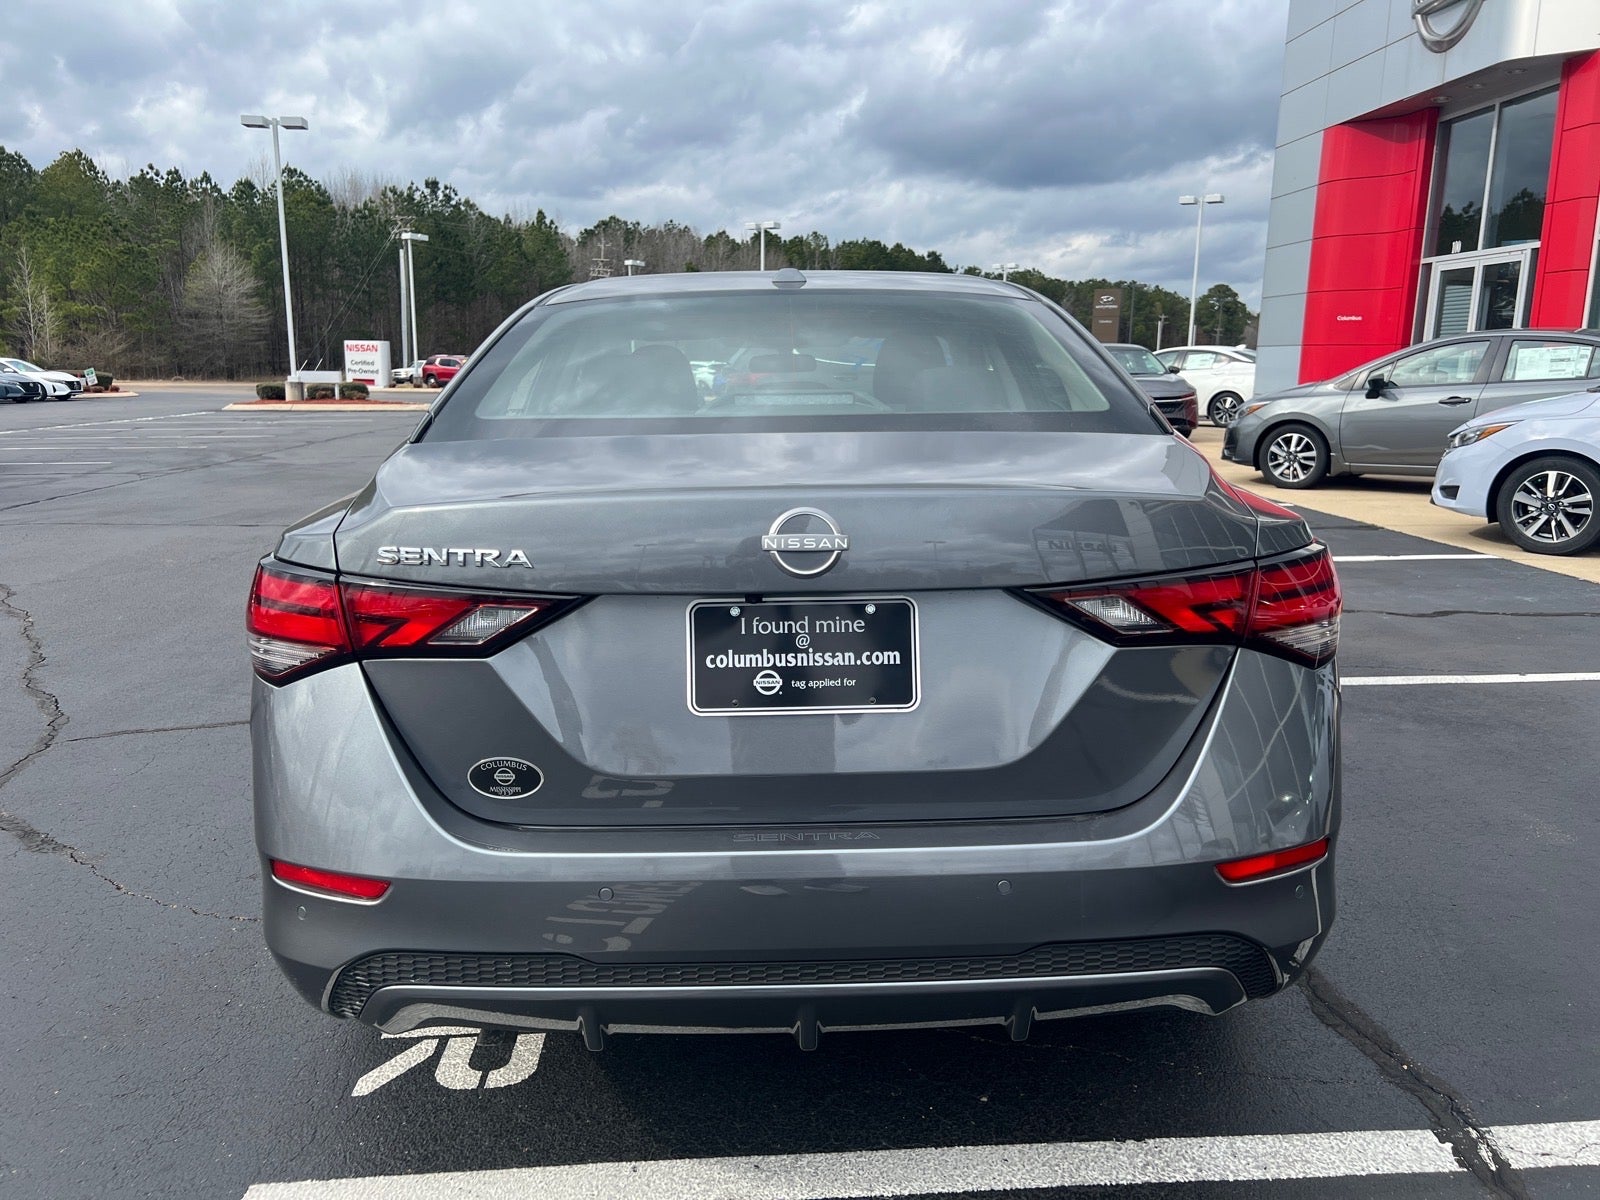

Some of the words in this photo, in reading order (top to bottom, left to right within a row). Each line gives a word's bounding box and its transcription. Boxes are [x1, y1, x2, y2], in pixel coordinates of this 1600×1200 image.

[345, 343, 379, 353] NISSAN
[350, 359, 375, 367] Certified
[347, 367, 379, 375] Pre-Owned
[764, 537, 848, 549] NISSAN
[376, 546, 534, 568] SENTRA
[740, 617, 746, 635] I
[752, 616, 809, 635] found
[815, 616, 866, 633] mine
[795, 633, 811, 649] @
[705, 647, 901, 669] columbusnissan.com
[791, 678, 806, 689] tag
[808, 677, 841, 689] applied
[843, 677, 857, 687] for
[480, 760, 528, 771] COLUMBUS
[733, 831, 881, 842] SENTRA
